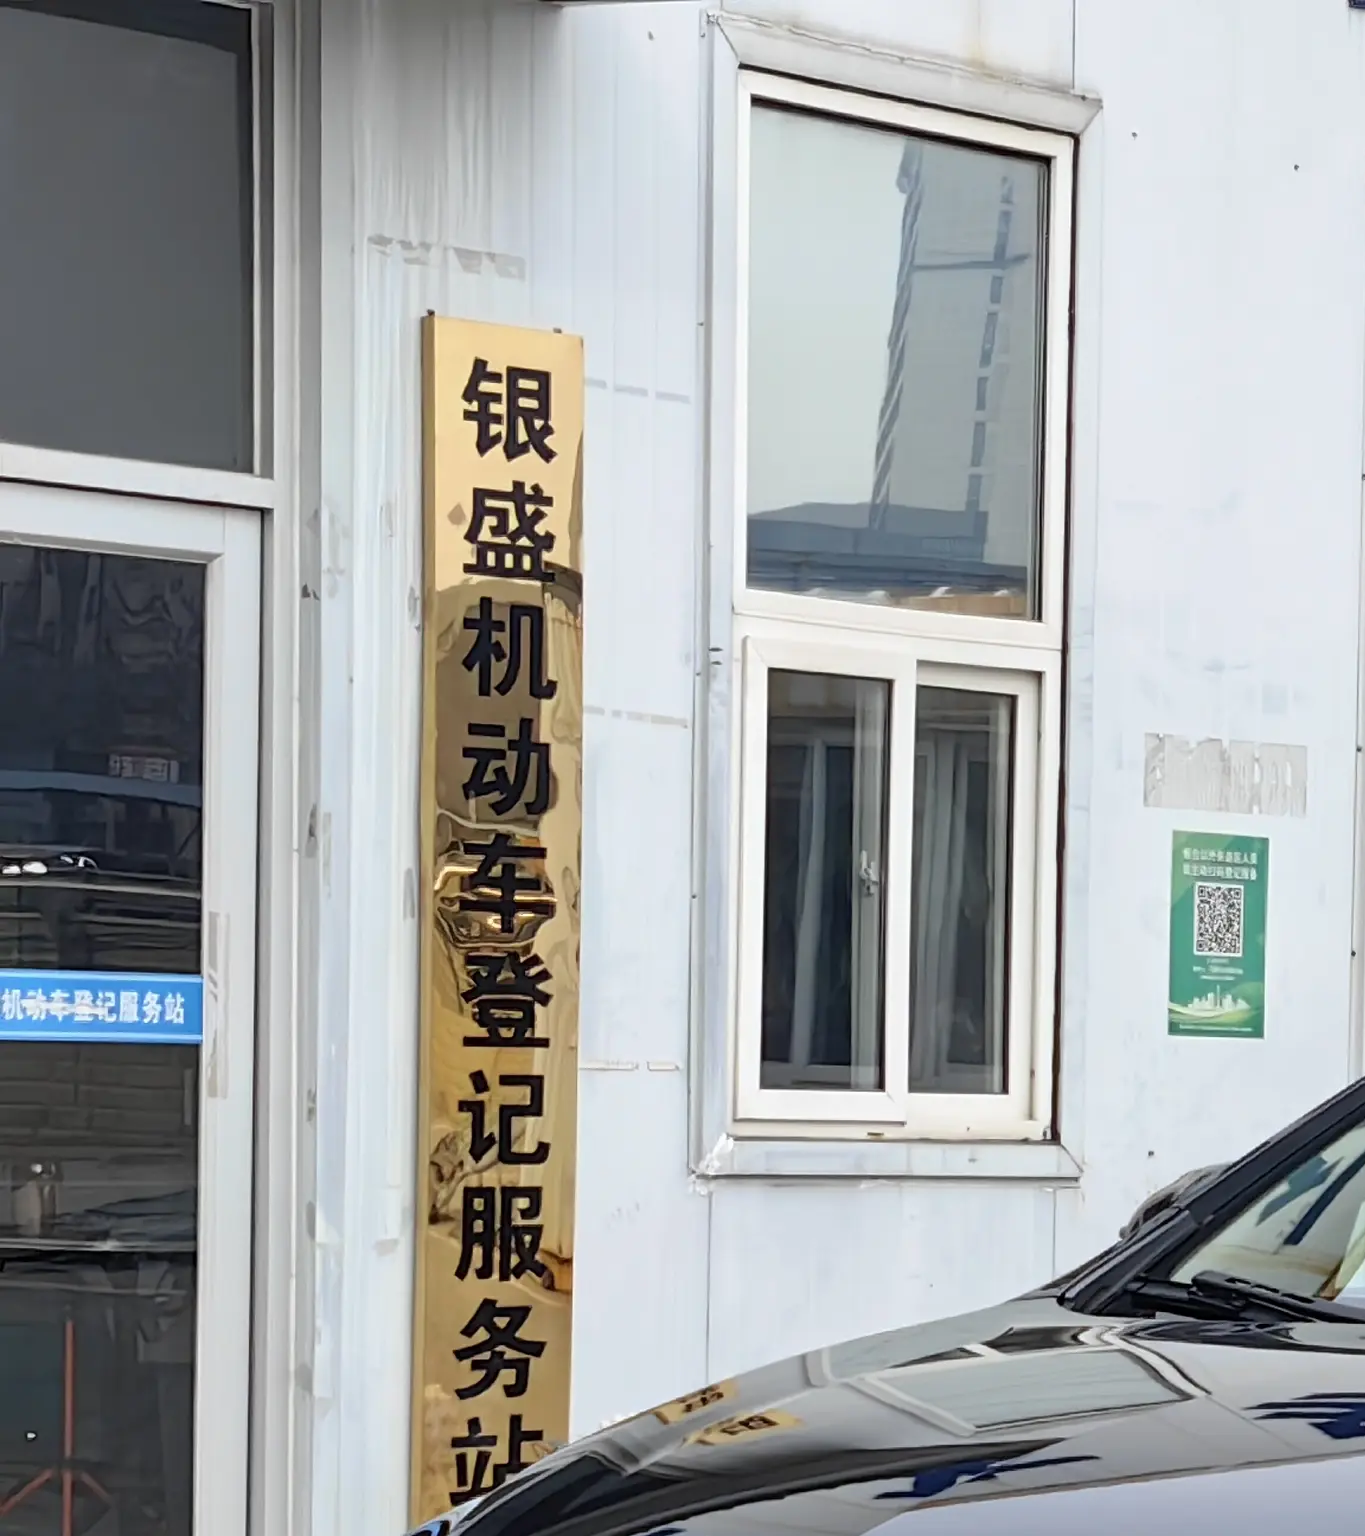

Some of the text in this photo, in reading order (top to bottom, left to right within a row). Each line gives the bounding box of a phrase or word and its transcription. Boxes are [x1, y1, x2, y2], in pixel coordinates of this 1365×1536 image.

[1, 988, 186, 1025] 机动车登记服务站
[449, 356, 559, 1507] 银盛机动车登记服务站
